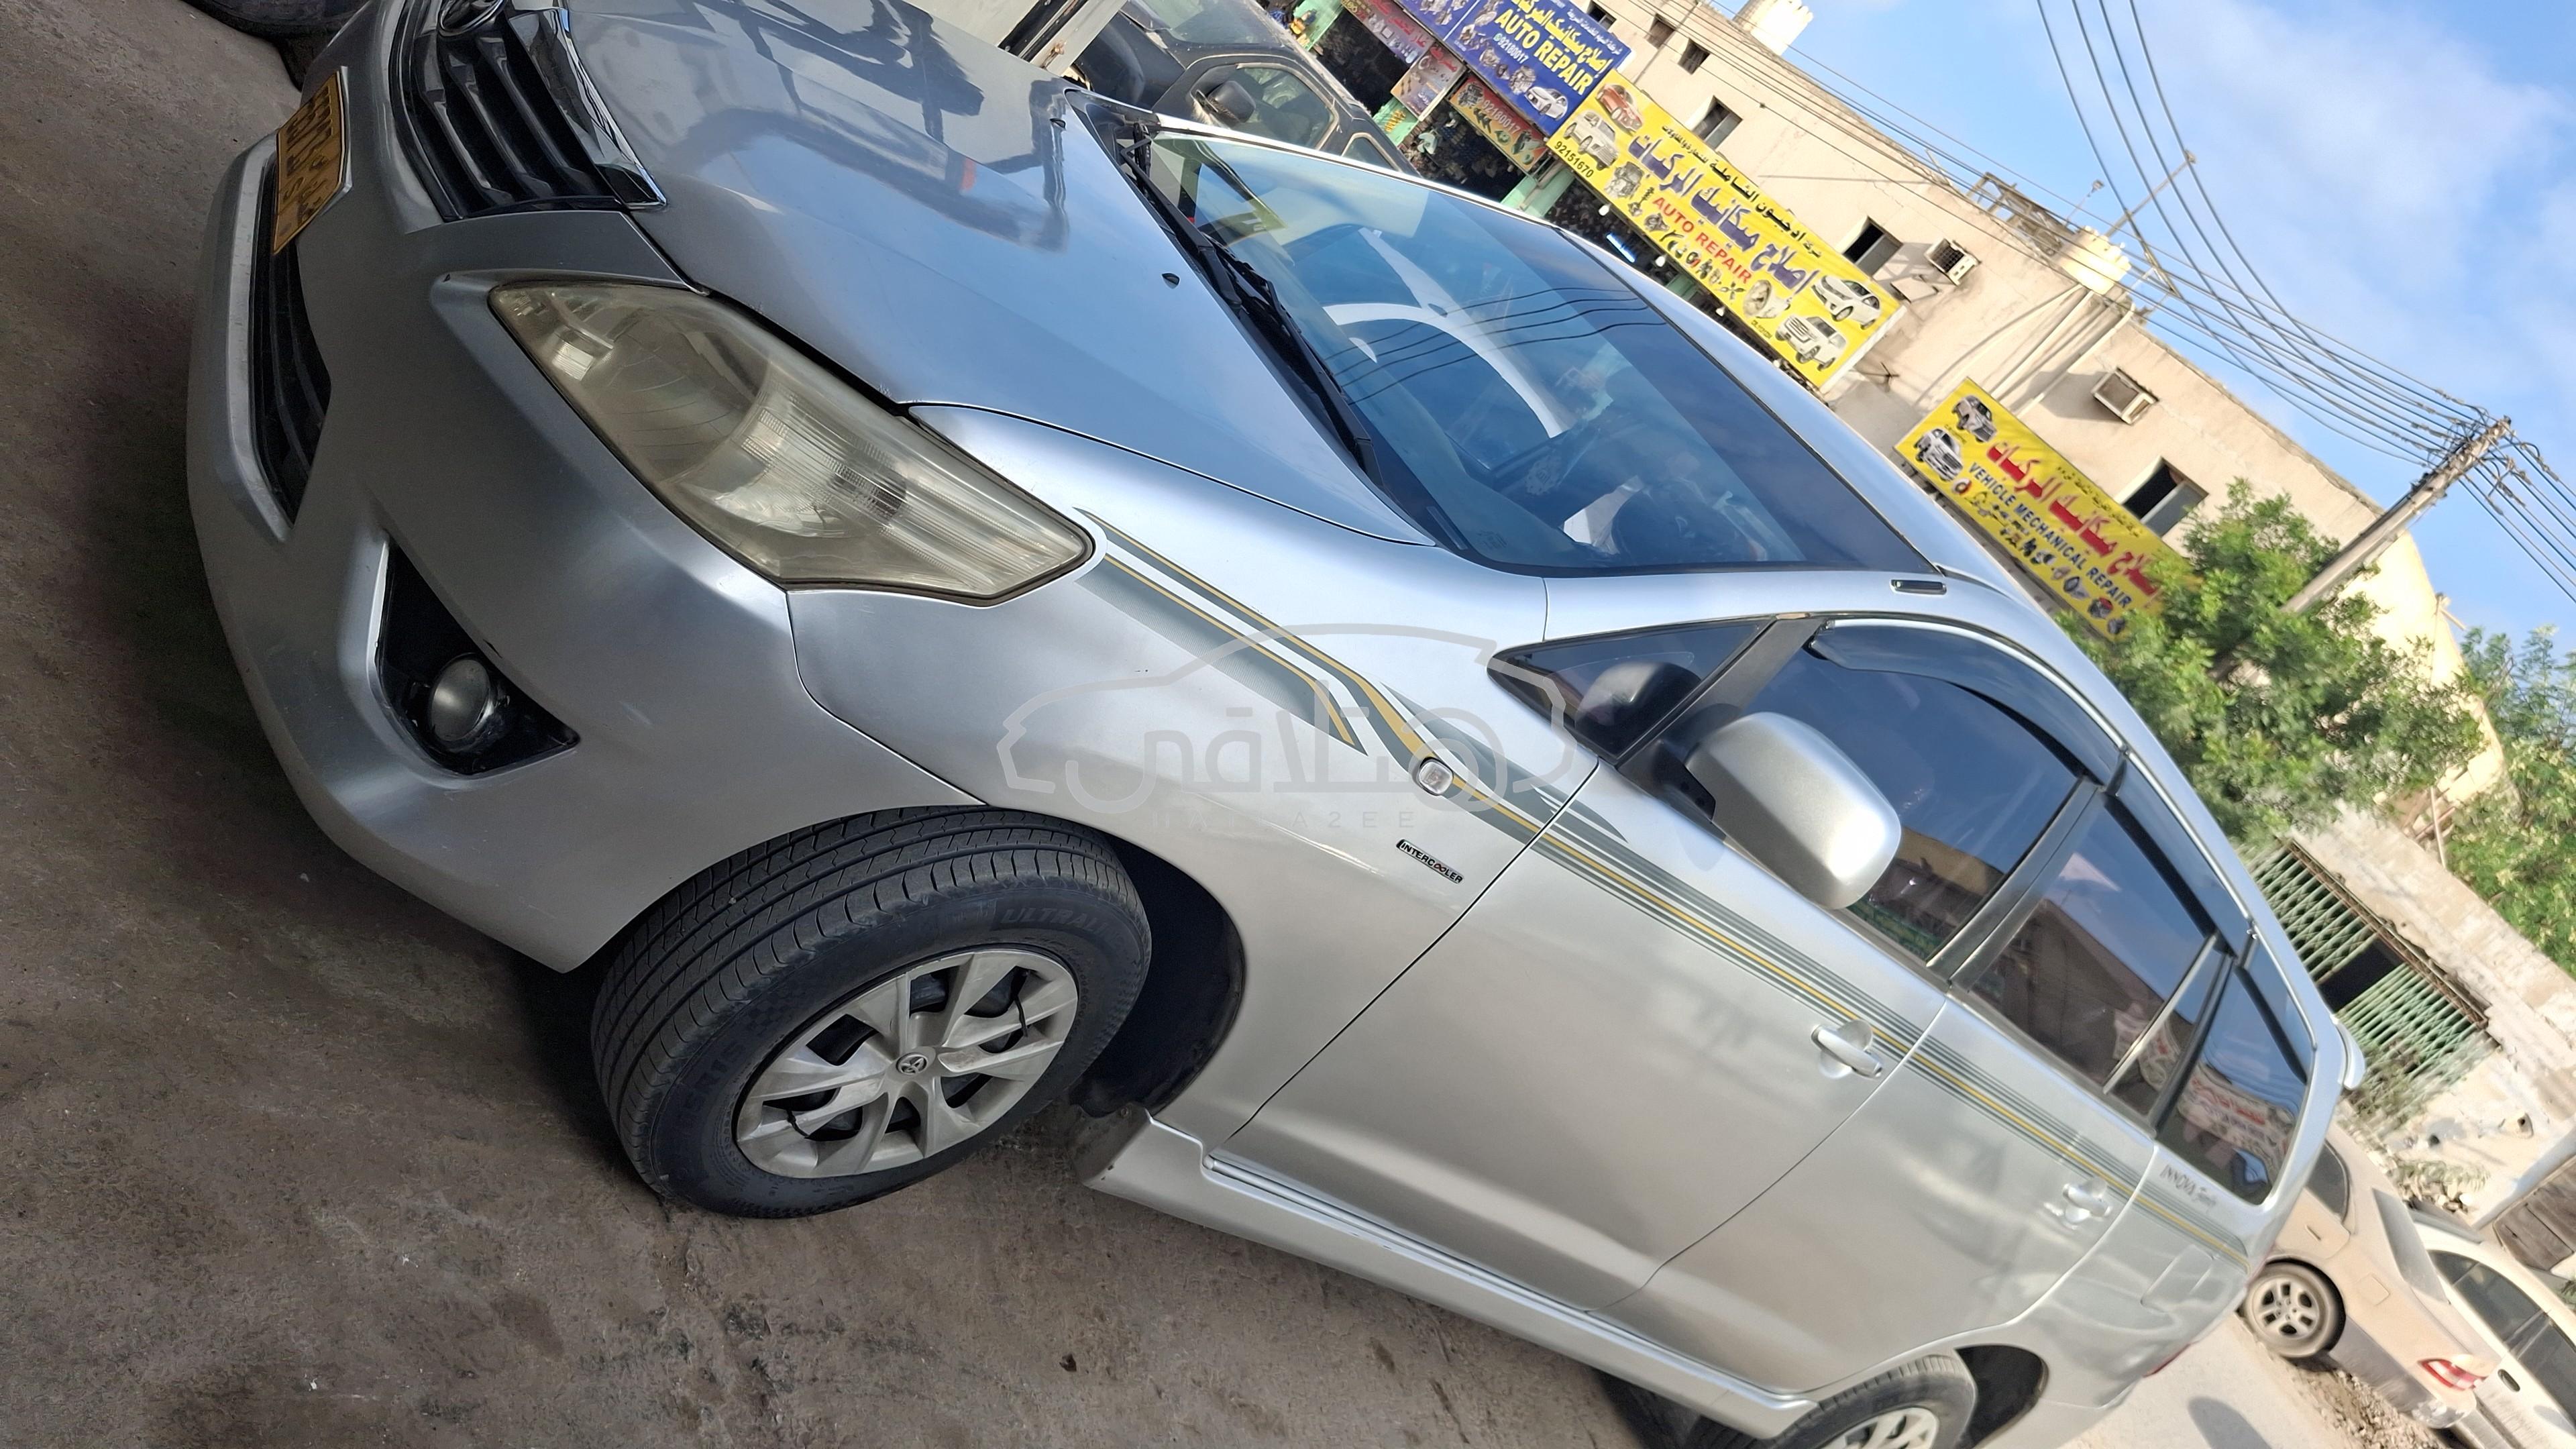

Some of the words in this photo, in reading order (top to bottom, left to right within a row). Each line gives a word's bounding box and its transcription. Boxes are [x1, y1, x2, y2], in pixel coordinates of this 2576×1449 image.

[1495, 9, 1540, 49] AUTO
[1534, 40, 1593, 95] REPAIR
[1499, 38, 1529, 64] 92180017
[1482, 99, 1520, 134] 92180017
[1554, 141, 1594, 178] 92151670
[1628, 136, 1704, 197] المركبات
[1653, 197, 1695, 233] AUTO
[1695, 232, 1752, 284] REPAIR
[1690, 187, 1760, 252] ميكانيك
[1987, 441, 2063, 503] المركبات
[1969, 462, 2017, 506] VEHICLE
[2014, 502, 2087, 570] MECHANICAL
[2086, 567, 2132, 608] REPAIR
[2049, 495, 2118, 558] ميكانيك
[1399, 842, 1464, 883] INTERCOOLER
